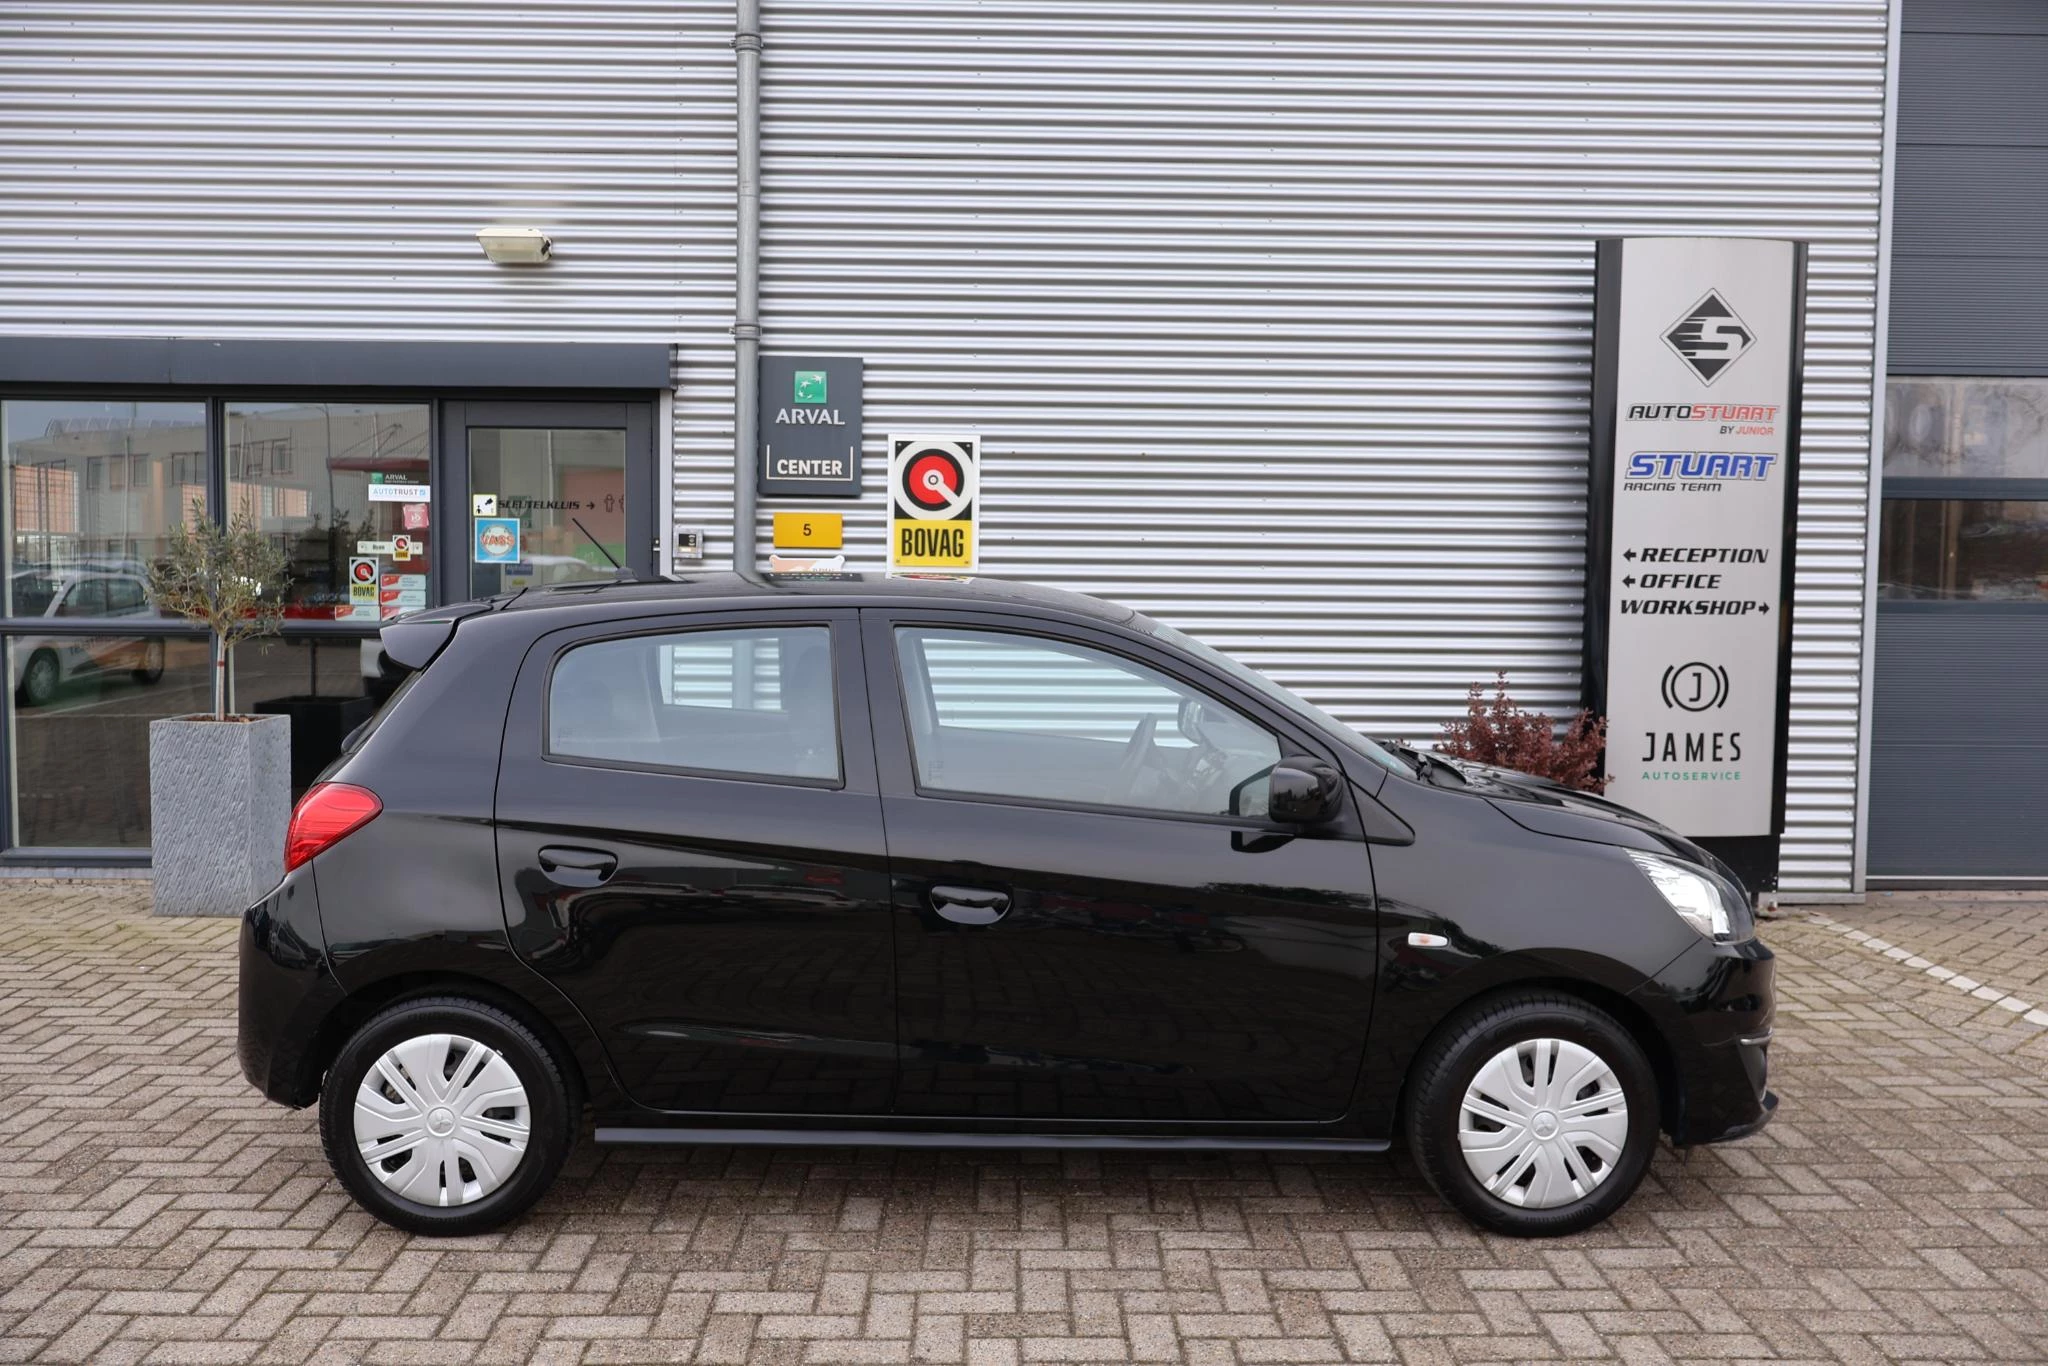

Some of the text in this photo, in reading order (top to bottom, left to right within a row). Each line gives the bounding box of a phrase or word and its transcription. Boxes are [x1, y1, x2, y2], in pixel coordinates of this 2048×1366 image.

[775, 408, 846, 426] ARVAL
[1626, 404, 1778, 422] AUTOSTUART
[1719, 425, 1774, 436] BY JUNIOR
[776, 459, 843, 476] CENTER
[1627, 453, 1776, 479] STUART
[385, 473, 408, 481] ARVAL
[373, 487, 419, 496] AUTOTRUST
[1623, 482, 1722, 492] RACING TEAM
[498, 500, 580, 510] SLEUTELKLUIS
[803, 523, 812, 536] 5
[901, 528, 964, 557] BOVAG
[1640, 548, 1769, 563] RECEPTION
[1640, 574, 1722, 589] OFFICE
[353, 586, 375, 597] BOVAG
[1620, 599, 1756, 615] WORKSHOP
[1642, 732, 1741, 762] JAMES
[1641, 771, 1741, 781] AUTOSERVICE
